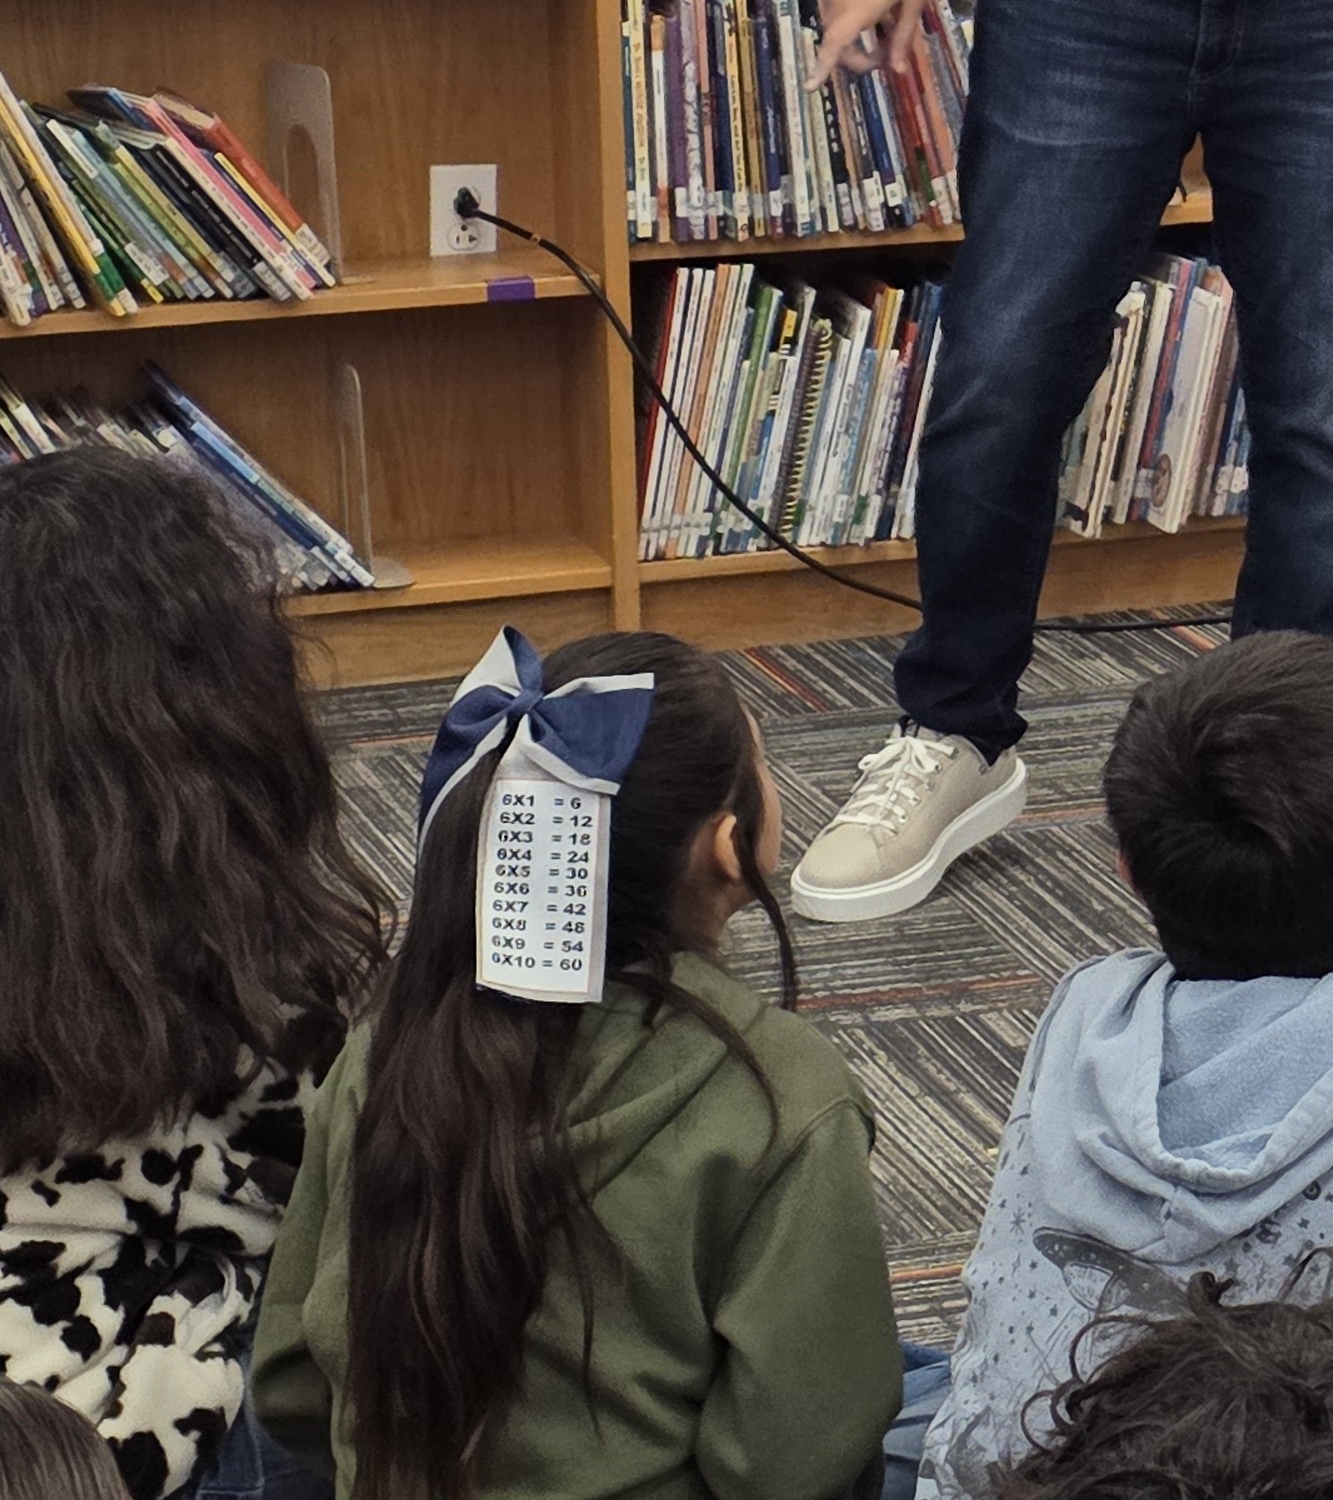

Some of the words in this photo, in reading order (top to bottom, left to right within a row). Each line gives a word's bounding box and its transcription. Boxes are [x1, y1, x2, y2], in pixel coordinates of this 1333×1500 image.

[502, 794, 535, 807] 6X1
[570, 797, 581, 809] 6
[500, 811, 535, 825] 6X2
[570, 815, 593, 827] 12
[498, 830, 533, 843] 6X3
[568, 833, 591, 845] 18
[497, 848, 532, 861] 6X4
[566, 851, 590, 863] 24
[495, 864, 531, 877] 6X5
[565, 867, 588, 879] 30
[493, 881, 529, 895] 6X6
[564, 885, 587, 897] 36
[492, 899, 529, 913] 6X7
[563, 903, 586, 915] 42
[491, 917, 527, 931] 6X8
[561, 921, 585, 934] 48
[491, 935, 525, 949] 6X9
[561, 940, 584, 952] 54
[491, 952, 536, 968] 6X10
[559, 957, 582, 971] 60
